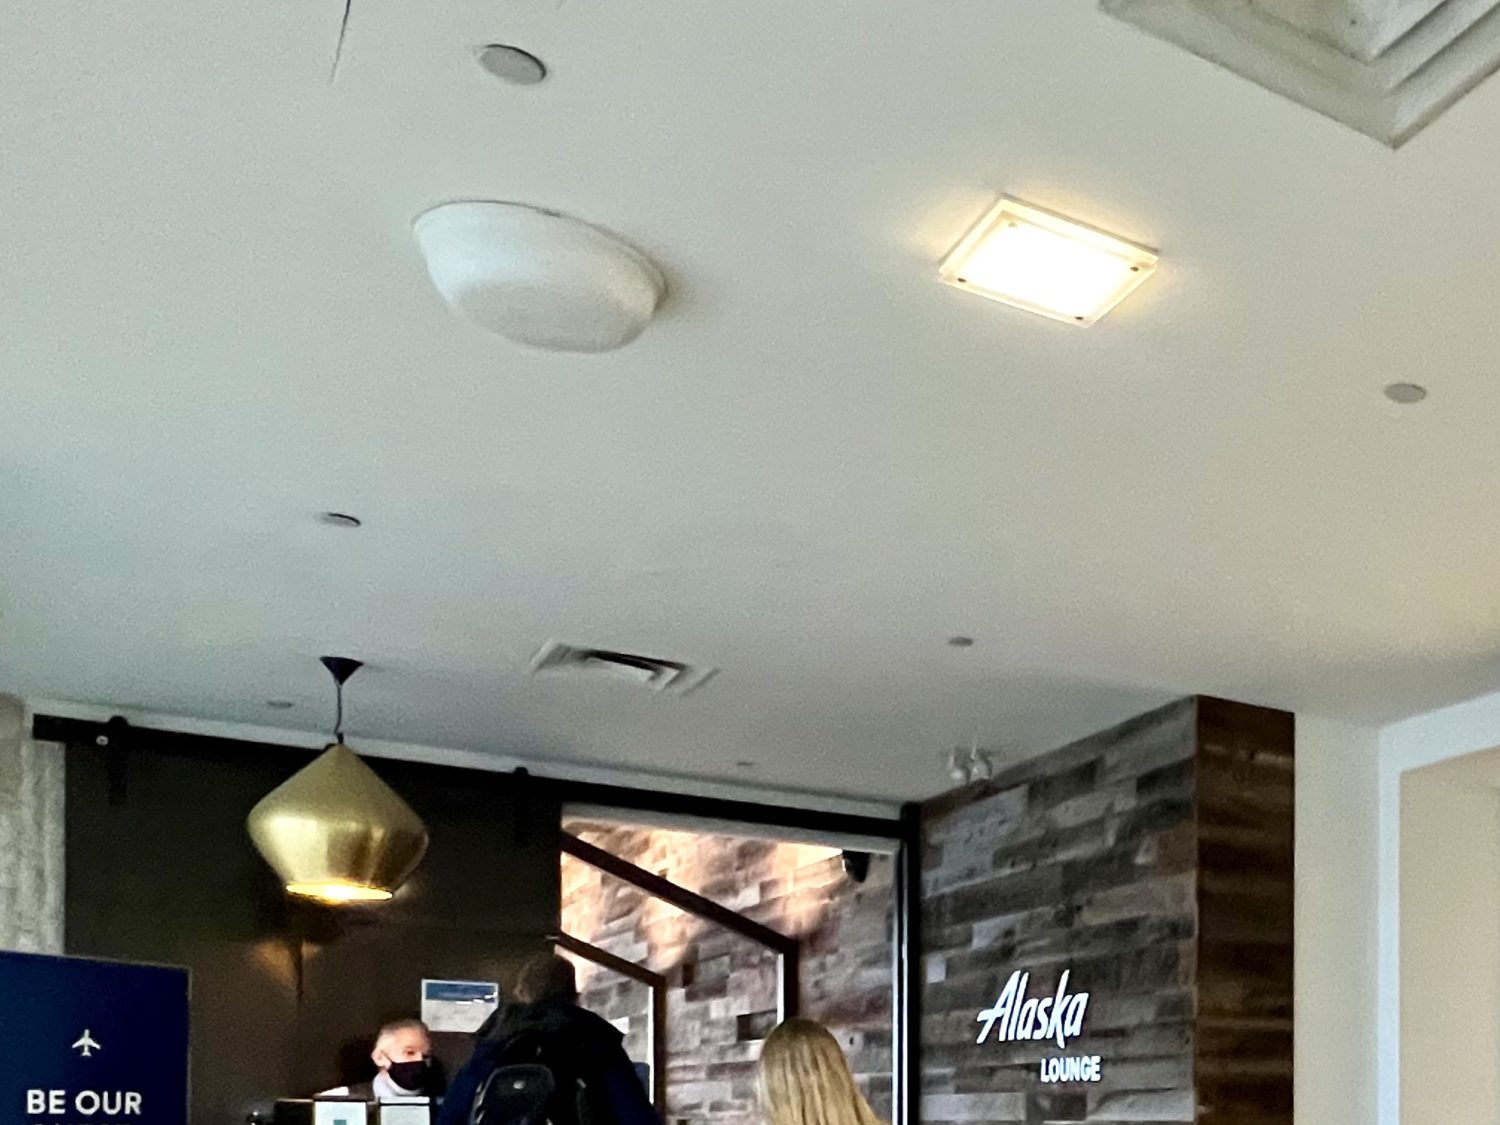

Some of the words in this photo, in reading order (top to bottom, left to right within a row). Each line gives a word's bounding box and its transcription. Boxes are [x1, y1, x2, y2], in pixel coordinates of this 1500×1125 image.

[976, 969, 1090, 1049] Alaska
[1040, 1055, 1102, 1083] LOUNGE
[26, 1089, 66, 1115] BE
[75, 1090, 143, 1115] OUR
